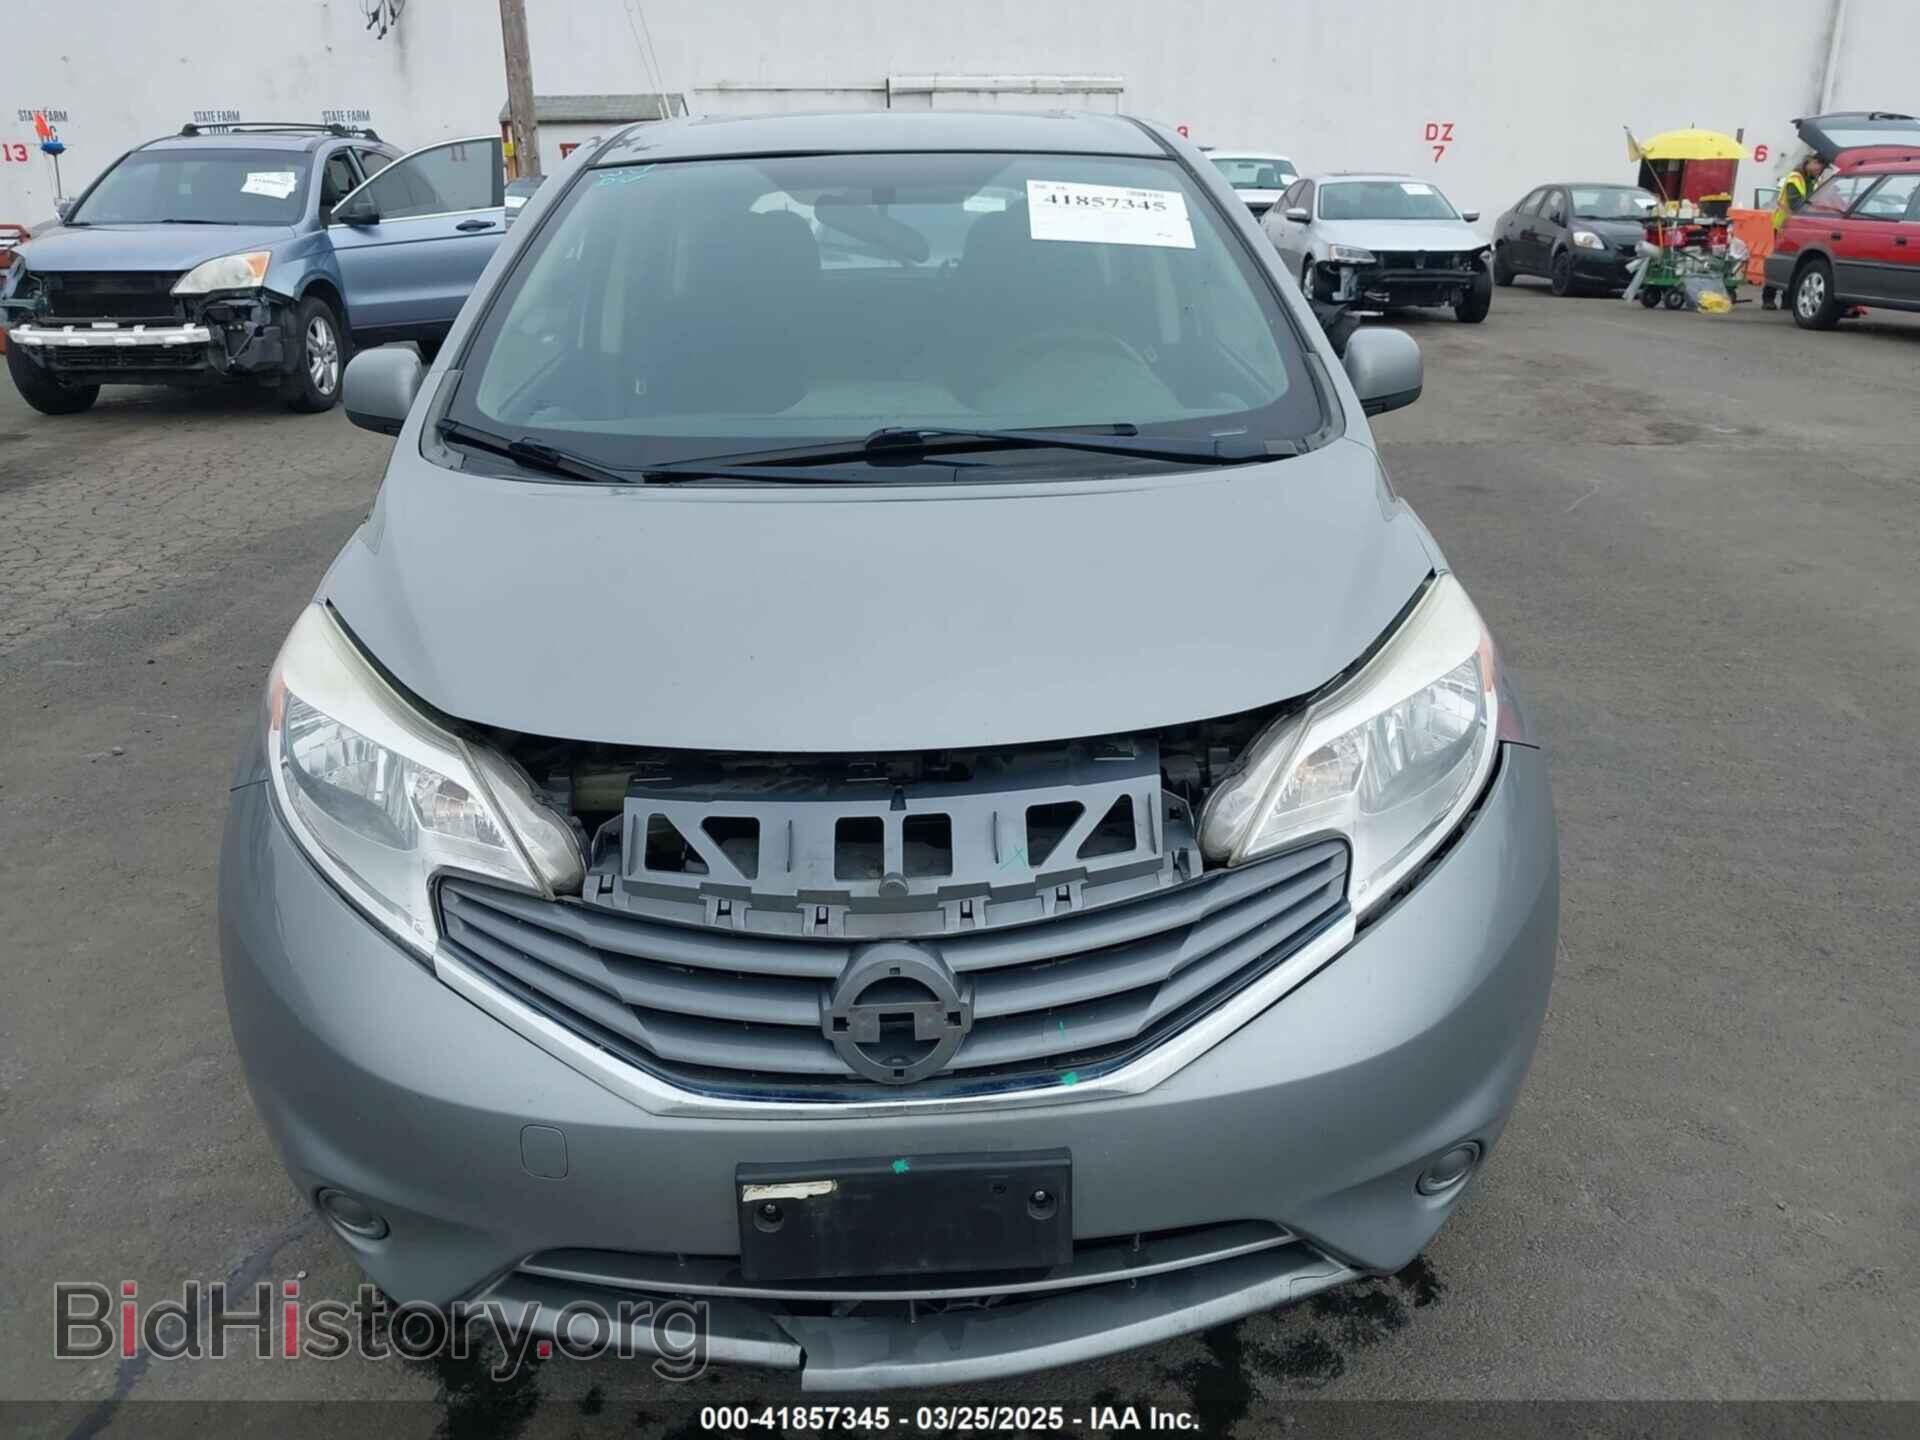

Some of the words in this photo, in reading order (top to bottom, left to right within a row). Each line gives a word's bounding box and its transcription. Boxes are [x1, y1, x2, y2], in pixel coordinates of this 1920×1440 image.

[193, 110, 216, 122] STATE
[217, 110, 240, 121] FARM
[322, 110, 345, 122] STATE
[347, 110, 370, 121] FARM
[1425, 123, 1454, 141] DZ
[2, 143, 28, 162] 13
[1433, 145, 1445, 163] 7
[1754, 145, 1768, 162] 6
[1044, 194, 1168, 212] 41857345
